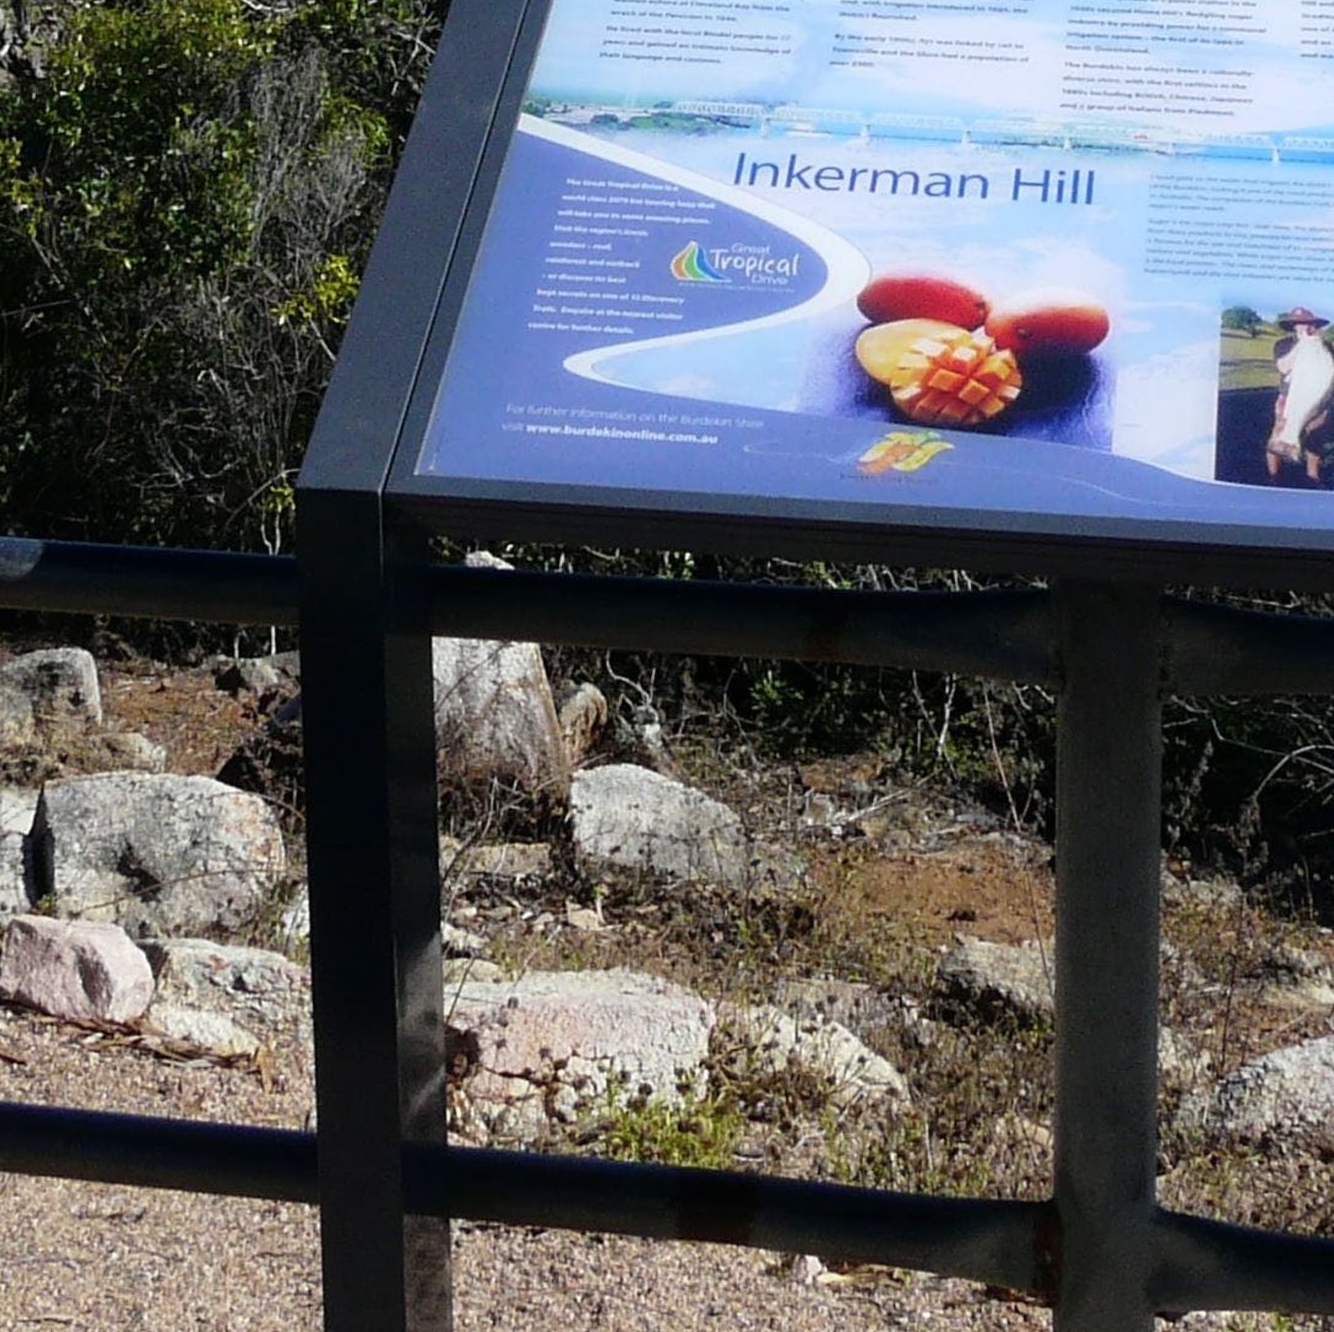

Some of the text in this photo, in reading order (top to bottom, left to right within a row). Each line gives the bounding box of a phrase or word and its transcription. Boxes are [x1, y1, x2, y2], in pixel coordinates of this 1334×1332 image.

[733, 152, 1094, 203] Inkerman Hill
[731, 242, 772, 256] Great
[708, 247, 800, 279] Tropical
[751, 271, 790, 286] Drive
[506, 403, 524, 414] For
[527, 404, 569, 418] further
[570, 407, 637, 422] information
[639, 413, 656, 423] on
[526, 422, 719, 445] www.burdekinonline.com.au
